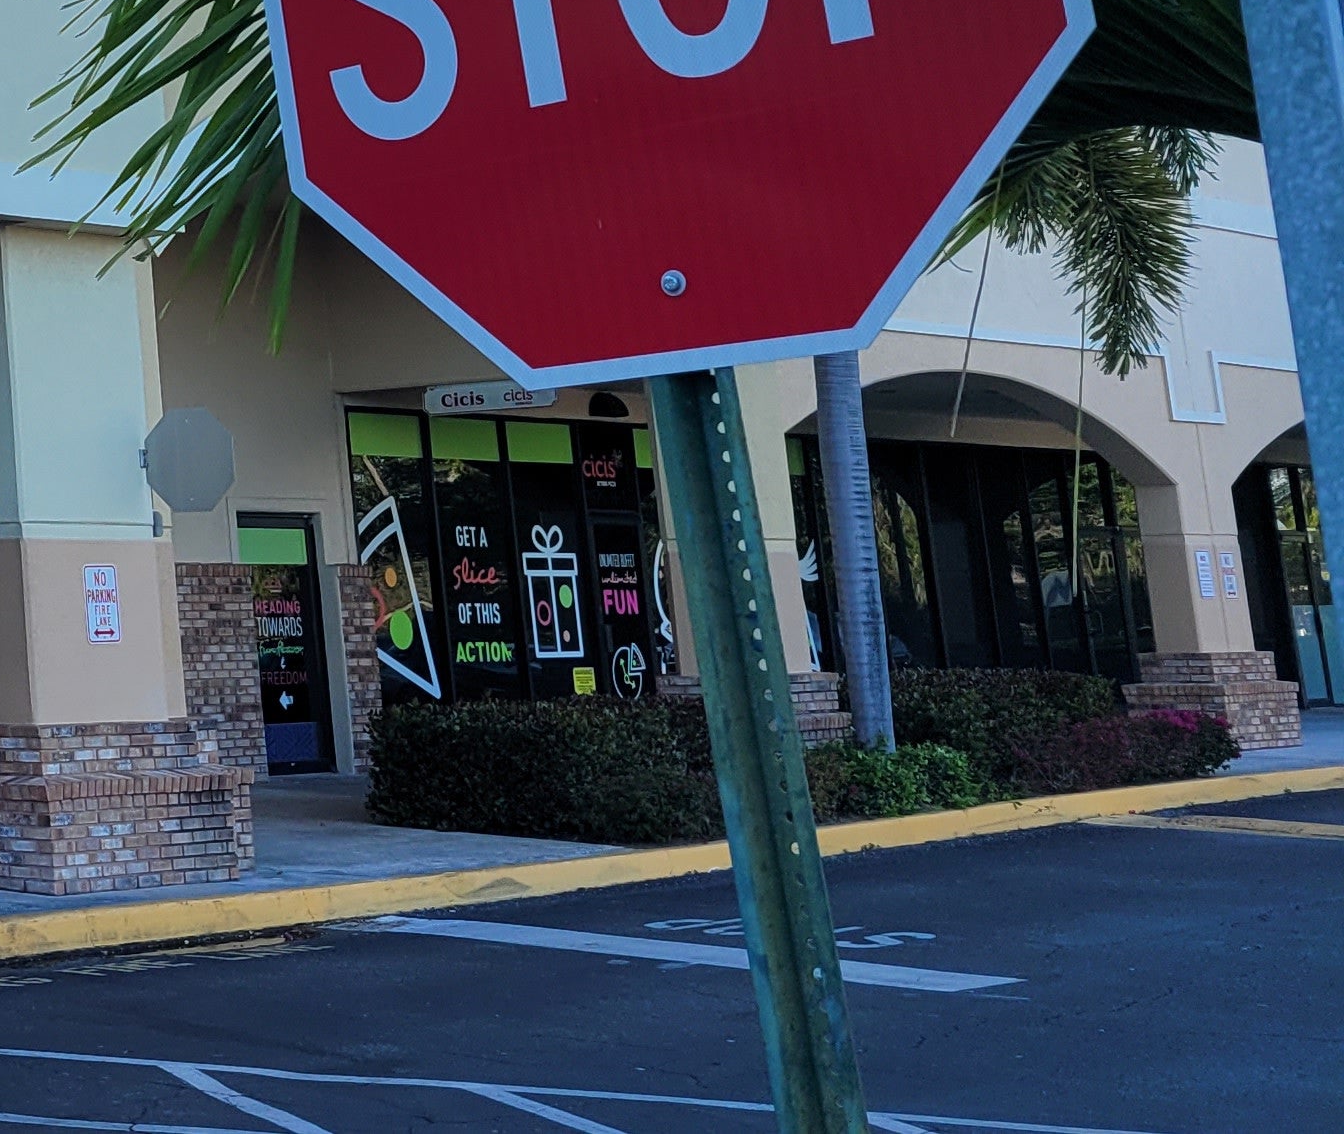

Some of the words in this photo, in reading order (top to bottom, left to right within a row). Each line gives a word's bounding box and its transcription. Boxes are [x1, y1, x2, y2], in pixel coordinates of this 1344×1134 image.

[441, 391, 485, 408] Cicis
[503, 389, 533, 402] cicis
[582, 454, 616, 479] cicis
[455, 526, 476, 547] GET
[479, 526, 489, 548] A
[93, 571, 107, 587] NO
[453, 556, 500, 591] slice
[87, 588, 116, 604] PARKING
[603, 588, 640, 615] FUN
[94, 605, 111, 616] FIRE
[254, 600, 301, 614] HEADING
[458, 602, 472, 624] OF
[474, 602, 502, 624] THIS
[95, 616, 112, 627] LANE
[256, 616, 303, 638] TOWARDS
[455, 641, 512, 663] ACTION
[261, 670, 308, 686] FREEDOM
